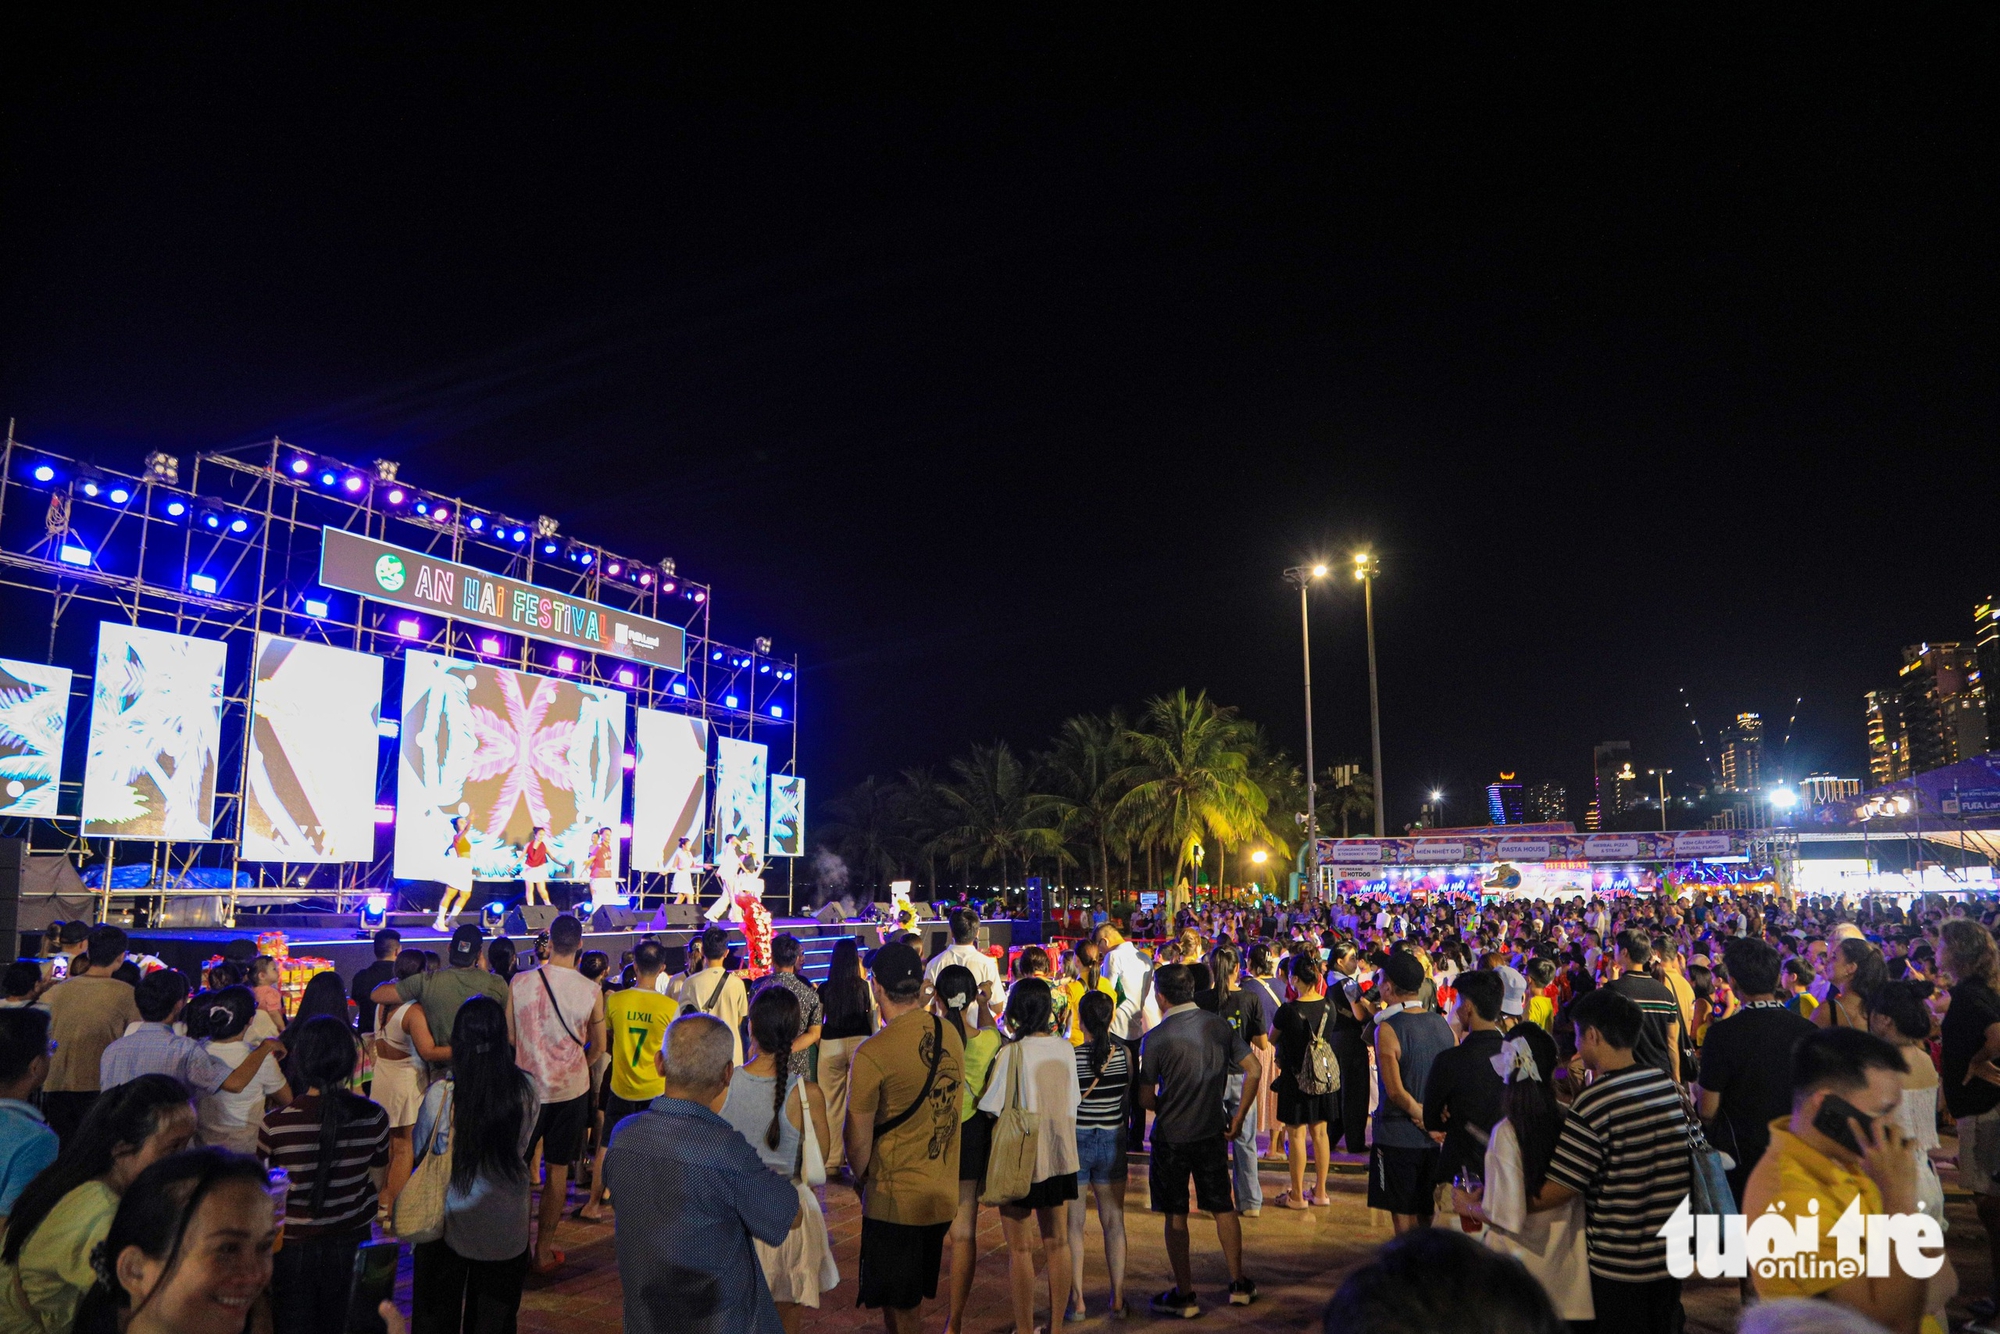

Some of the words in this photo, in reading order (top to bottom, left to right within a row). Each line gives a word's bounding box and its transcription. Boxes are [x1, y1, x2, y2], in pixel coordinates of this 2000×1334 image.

[414, 564, 454, 605] AN
[512, 588, 609, 644] FESTIVAL
[1962, 802, 1984, 810] FUTA
[1545, 861, 1590, 870] HERBAL
[1359, 884, 1372, 893] AN
[1437, 883, 1450, 892] AN
[1599, 881, 1612, 890] AN
[627, 1011, 654, 1023] LIXIL
[628, 1027, 648, 1067] 7
